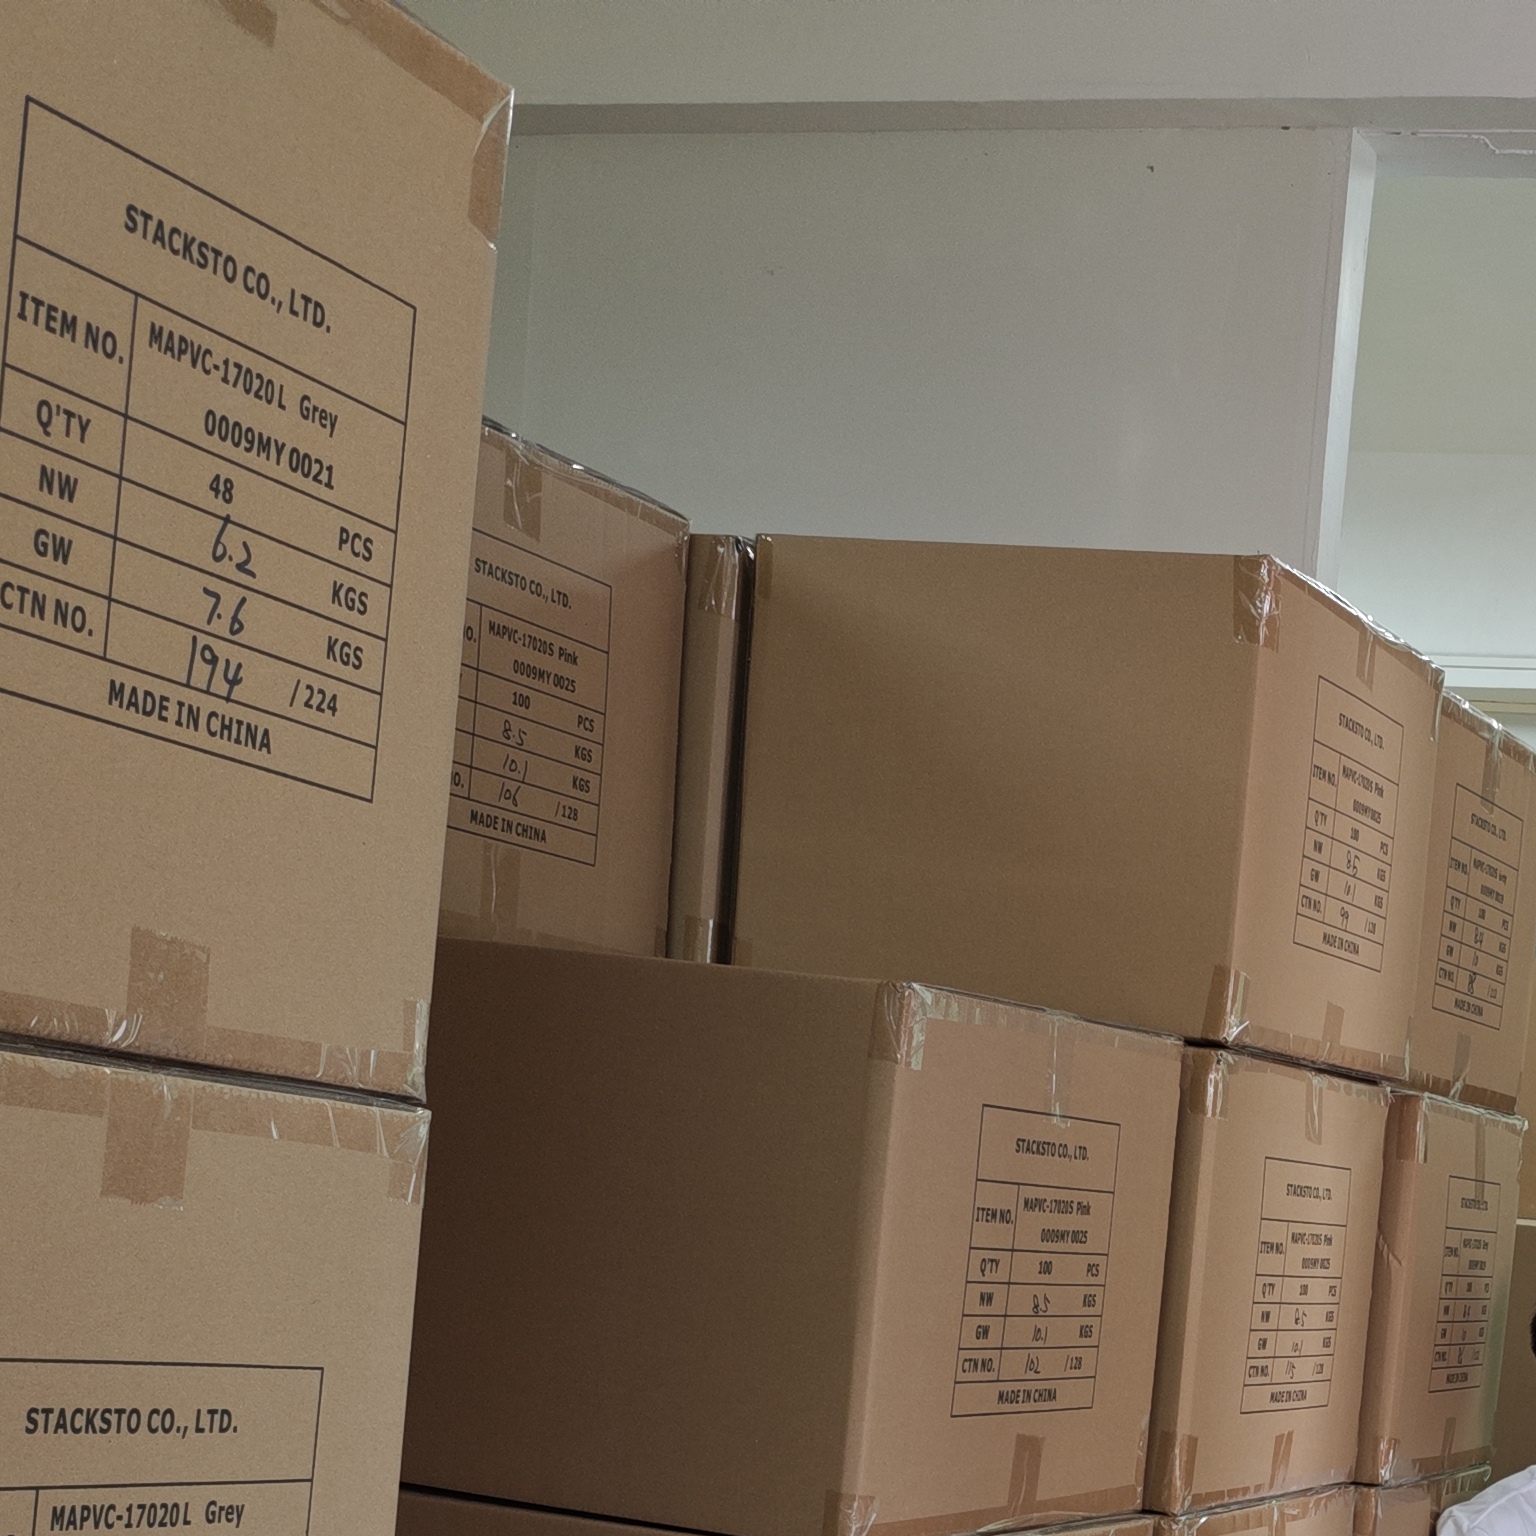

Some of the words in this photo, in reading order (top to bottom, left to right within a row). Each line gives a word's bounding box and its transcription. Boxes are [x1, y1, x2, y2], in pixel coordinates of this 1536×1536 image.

[124, 203, 238, 284] STACKSTO
[242, 265, 283, 314] CO.,
[289, 288, 331, 334] LTD.
[17, 290, 78, 344] ITEM
[84, 321, 124, 365] NO.
[36, 399, 92, 444] Q'TY
[299, 394, 339, 438] Grey
[38, 464, 79, 504] NW
[209, 473, 234, 505] 48
[338, 526, 374, 563] PCS
[33, 528, 73, 566] GW
[210, 513, 258, 579] 6.2
[331, 580, 369, 616] KGS
[474, 557, 527, 592] STACKSTO
[528, 579, 549, 604] CO.,
[550, 588, 572, 610] LTD.
[0, 581, 47, 622] CTN
[53, 598, 93, 637] NO.
[202, 586, 248, 637] 7.6
[326, 635, 364, 671] KGS
[488, 620, 555, 657] MAPVC-17020S
[558, 646, 579, 667] Pink
[185, 635, 244, 702] 194
[108, 678, 170, 723] MADE
[174, 700, 201, 732] IN
[206, 710, 272, 755] CHINA
[512, 691, 531, 710] 100
[577, 714, 595, 733] PCS
[502, 719, 528, 747] 8.5
[502, 753, 528, 783] 10.1
[574, 744, 593, 764] KGS
[498, 781, 521, 808] 106
[572, 775, 591, 794] KGS
[469, 809, 500, 831] MADE
[500, 817, 514, 835] IN
[515, 822, 547, 844] CHINA
[1015, 1137, 1057, 1158] STACKSTO
[1073, 1145, 1089, 1161] LTD.
[973, 1203, 998, 1224] ITEM
[998, 1208, 1014, 1225] NO.
[1075, 1201, 1092, 1216] Pink
[979, 1257, 1001, 1278] Q'TY
[1037, 1260, 1053, 1276] 100
[1086, 1262, 1100, 1278] PCS
[979, 1291, 995, 1307] NW
[1082, 1293, 1097, 1308] KGS
[975, 1324, 991, 1341] GW
[1078, 1324, 1094, 1339] KGS
[961, 1357, 980, 1374] CTN
[980, 1357, 995, 1373] NO.
[997, 1389, 1021, 1405] MADE
[1021, 1388, 1032, 1404] IN
[1032, 1387, 1057, 1404] CHINA
[24, 1407, 142, 1435] STACKSTO
[146, 1407, 189, 1440] CO.,
[194, 1408, 238, 1434] LTD.
[204, 1500, 245, 1529] Grey
